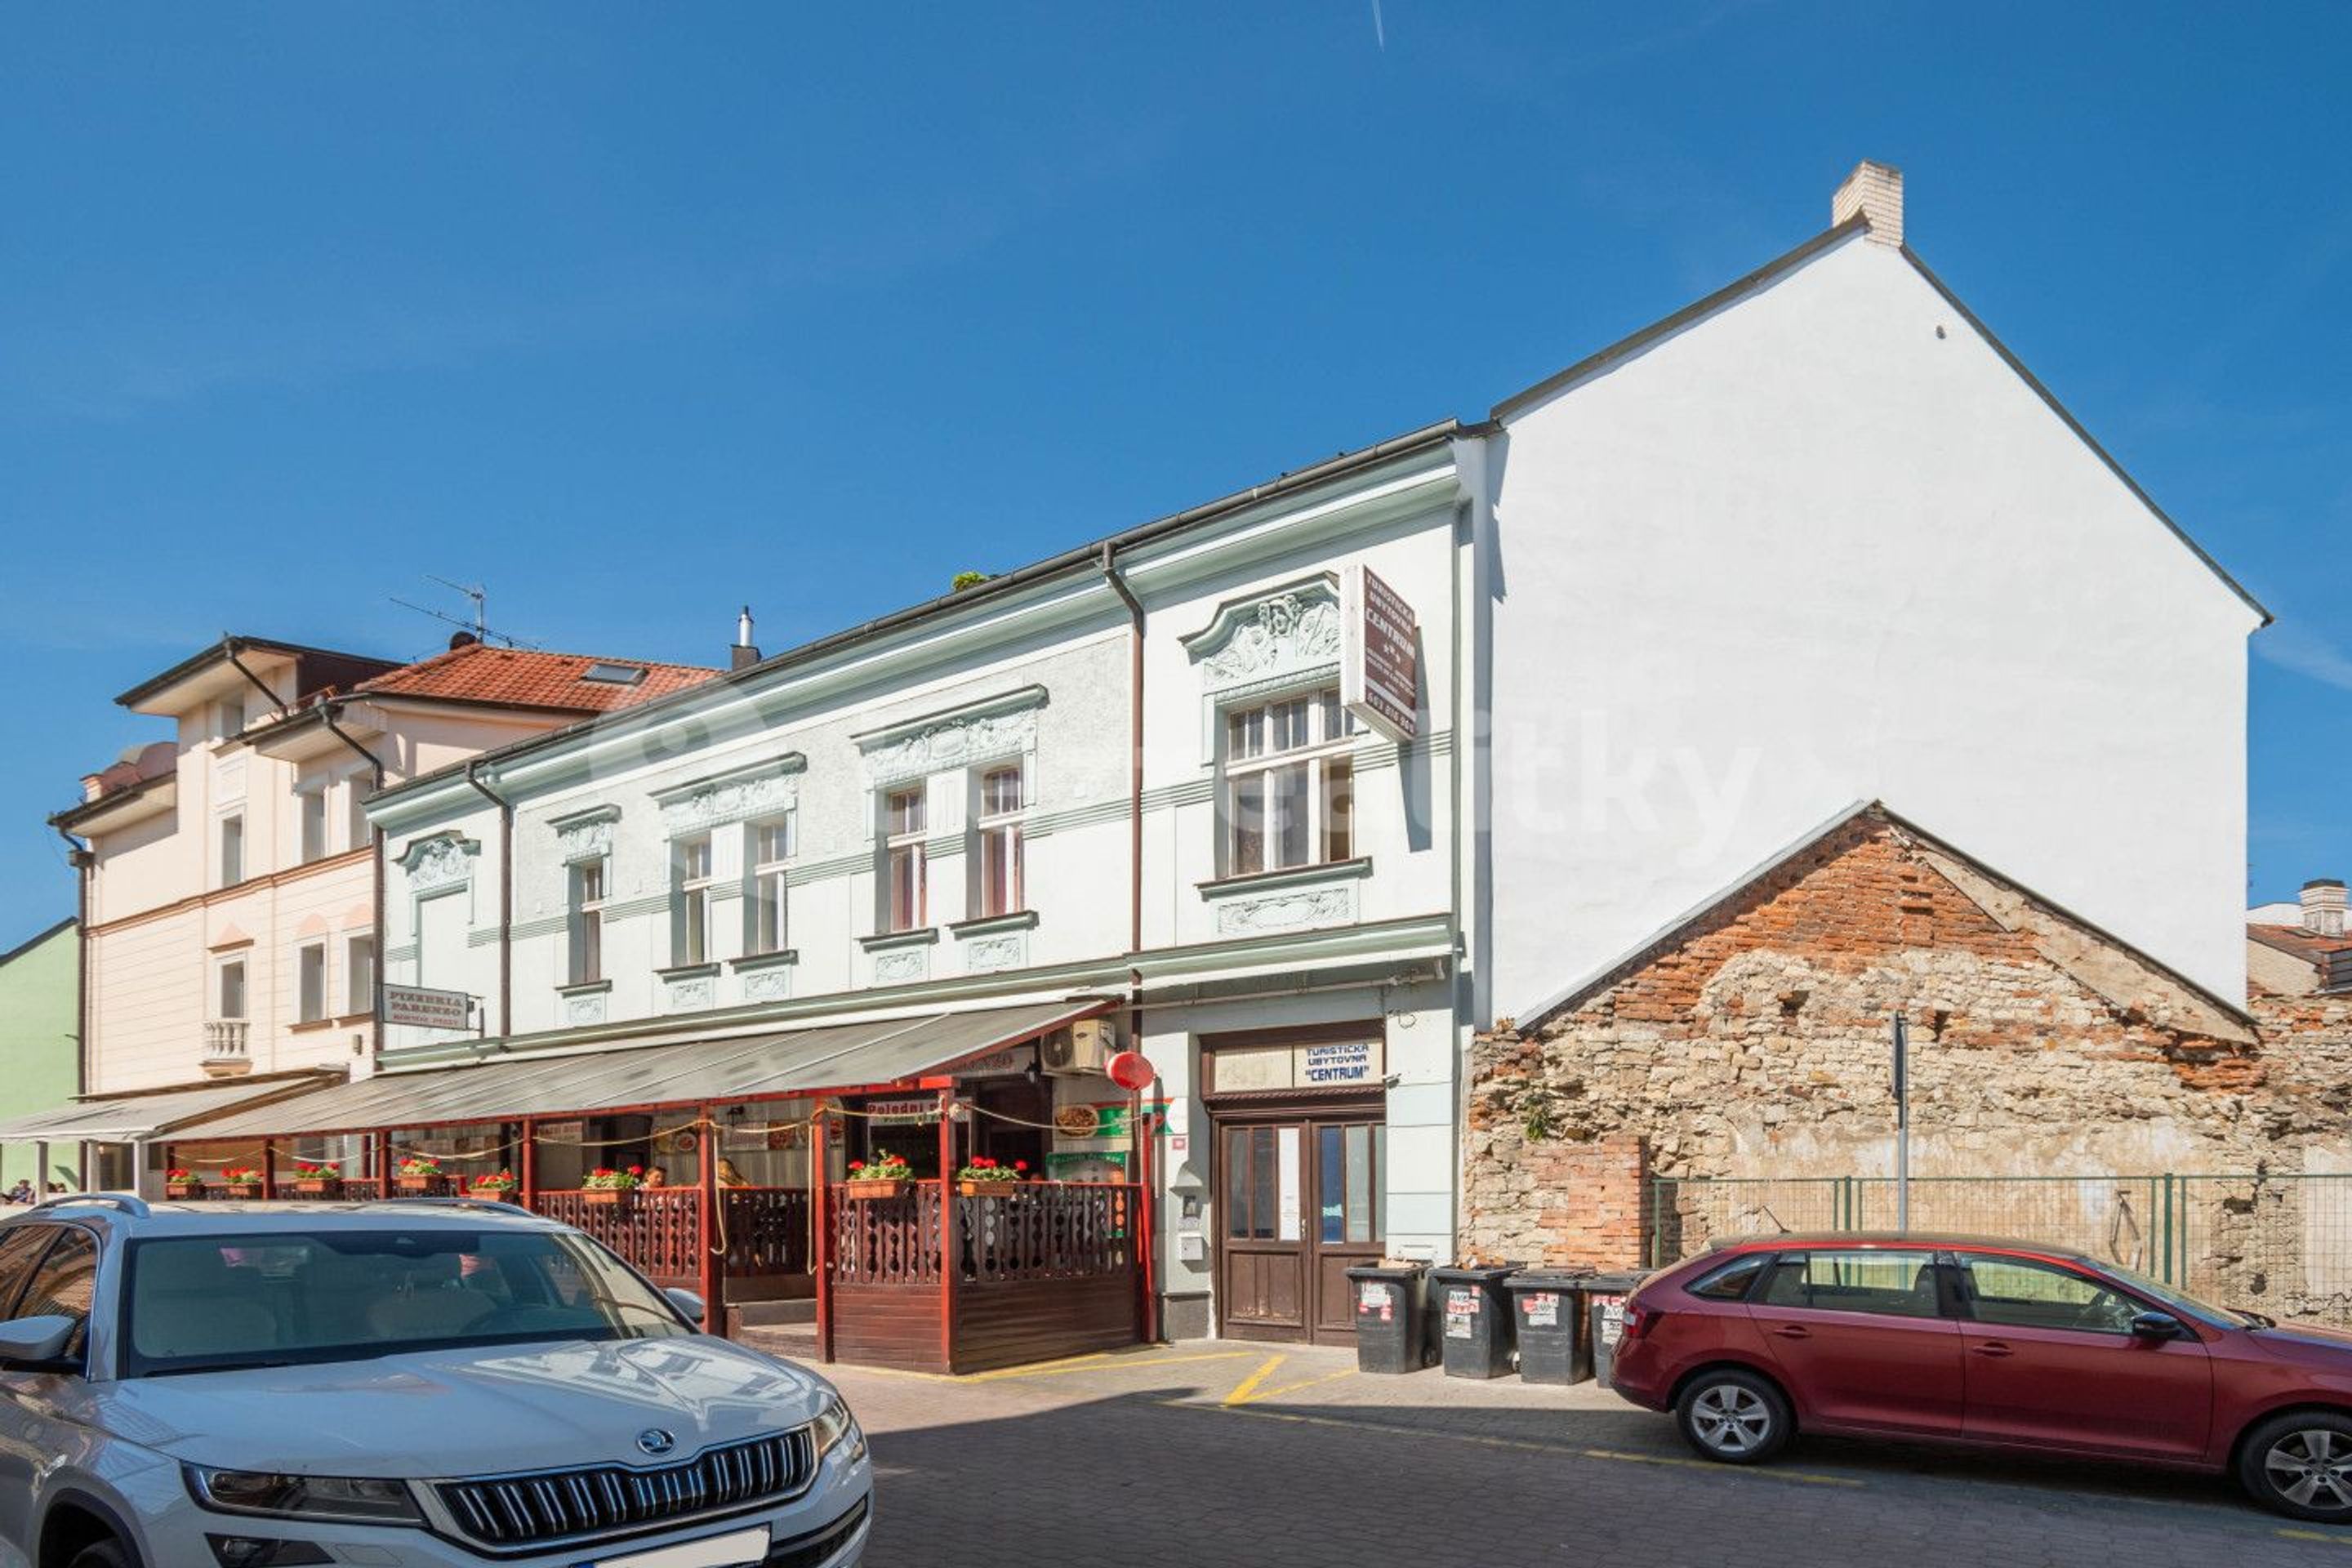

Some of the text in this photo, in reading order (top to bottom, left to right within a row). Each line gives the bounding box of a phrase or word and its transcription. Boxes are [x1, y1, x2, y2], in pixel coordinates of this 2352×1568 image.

[1365, 607, 1415, 660] CENTRUM
[391, 991, 462, 1007] PIZZERIA
[392, 1001, 461, 1017] PARENZO
[1308, 1054, 1366, 1066] UBYTOVNA
